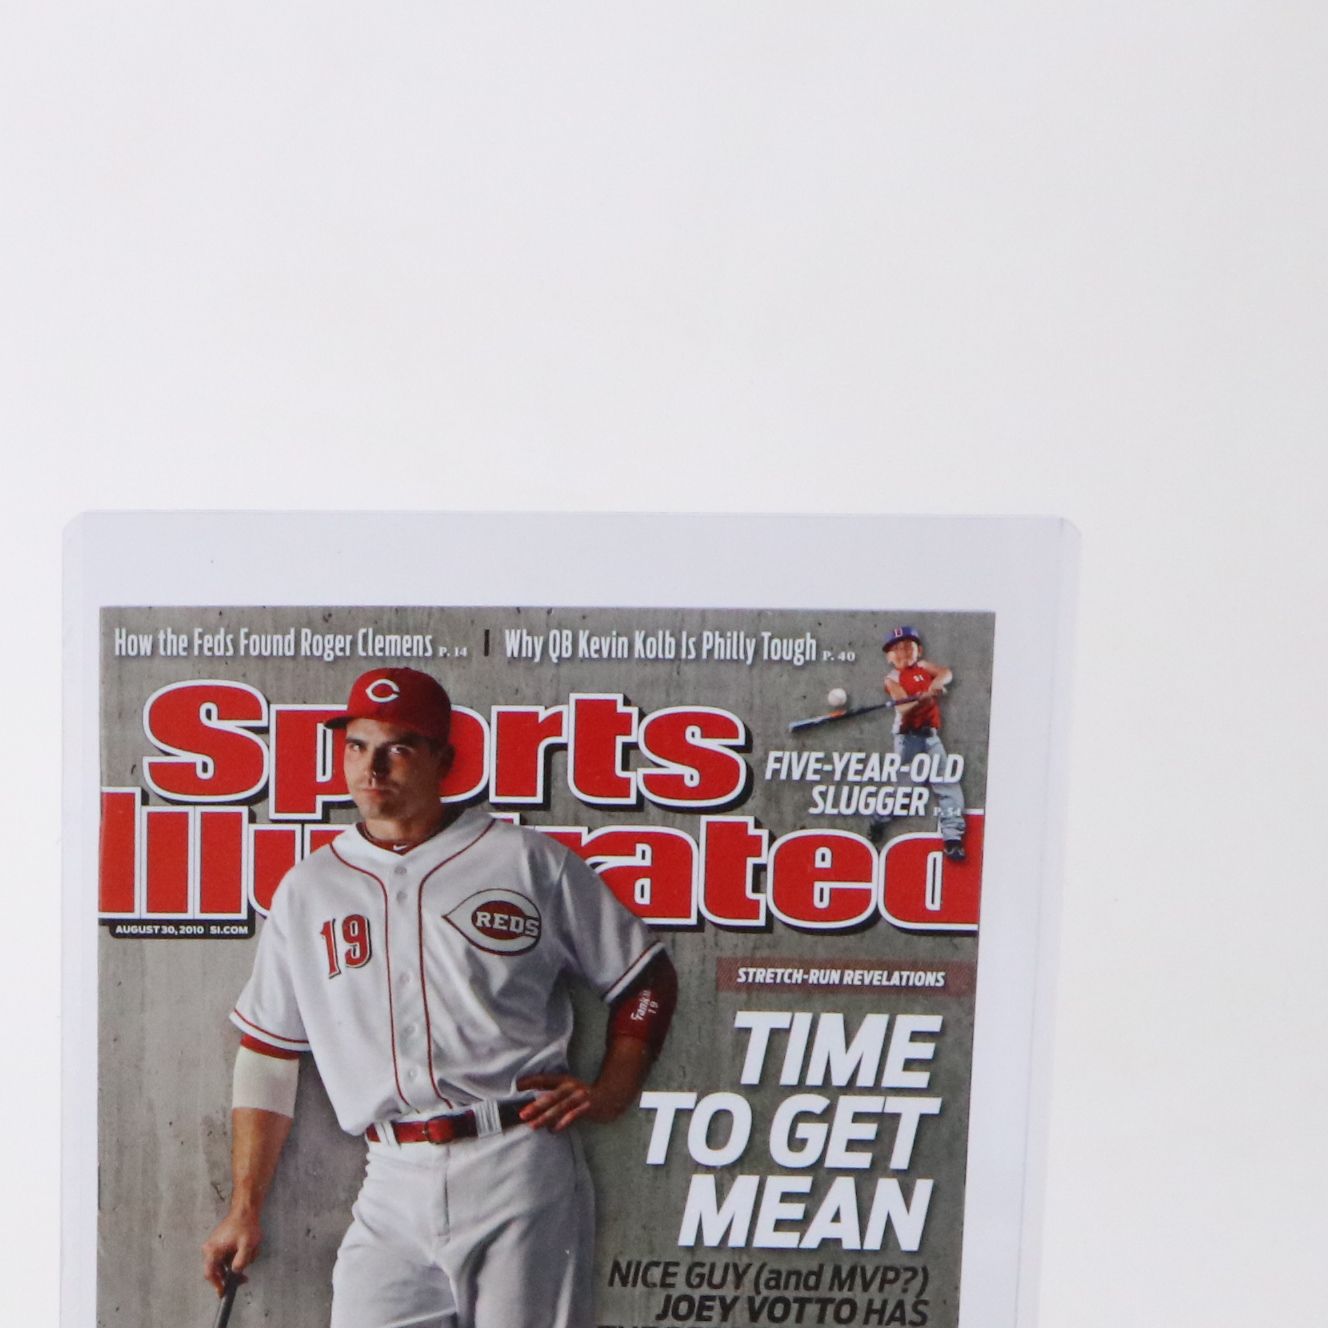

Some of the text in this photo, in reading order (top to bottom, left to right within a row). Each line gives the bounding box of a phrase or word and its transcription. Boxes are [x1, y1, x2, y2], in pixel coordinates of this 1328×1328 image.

[115, 627, 467, 661] How the Feds Found Roger Clemens 14
[505, 629, 856, 666] Why QB Kevin Kolb Is Philly Tough 40
[765, 751, 964, 783] FIVE-YEAR-OLD
[808, 787, 930, 816] SLUGGER
[115, 925, 249, 936] AUGUST 30, 2010 SI.COM
[475, 911, 540, 938] REDS
[320, 913, 373, 980] 19
[737, 967, 945, 987] STRETCH-RUN REVELATIONS
[734, 1010, 943, 1088] TIME
[639, 1092, 943, 1170] TO GET
[677, 1174, 934, 1251] MEAN
[608, 1260, 930, 1298] NICE GUY (and MVP?)
[655, 1294, 929, 1327] JOEY VOTTO HAS
